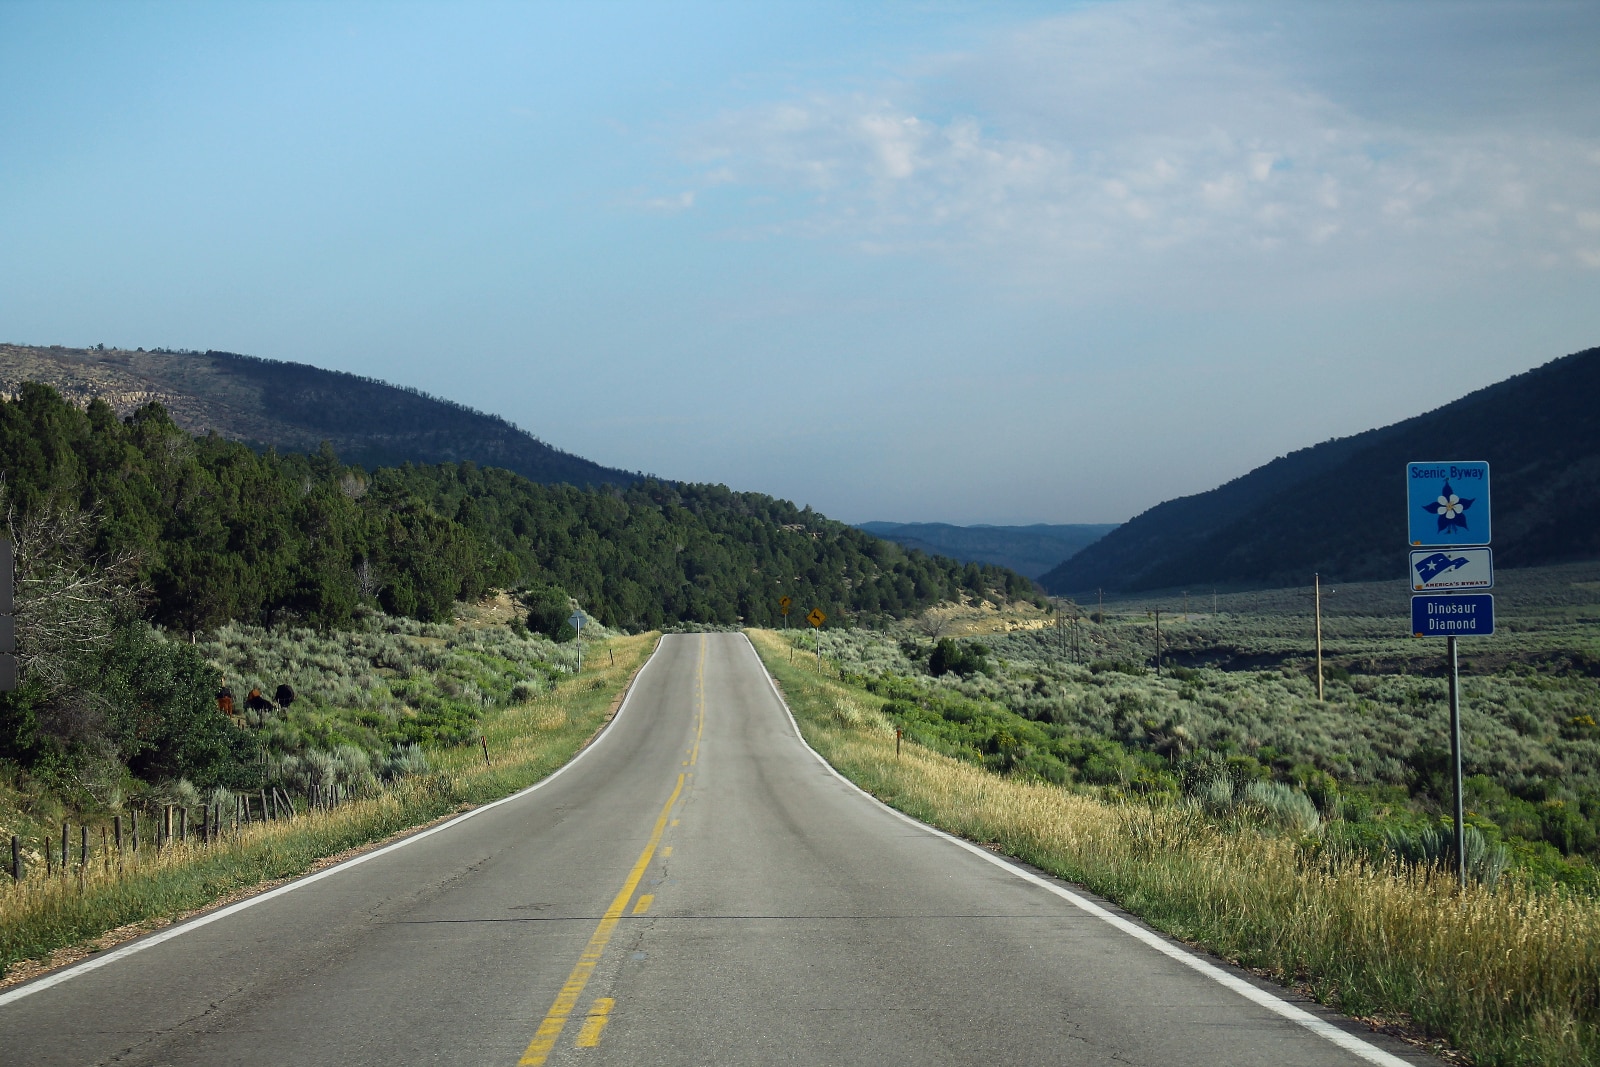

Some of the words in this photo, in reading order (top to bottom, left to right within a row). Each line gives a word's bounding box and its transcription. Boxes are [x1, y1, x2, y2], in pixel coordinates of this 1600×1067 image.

[1411, 466, 1446, 479] Scenic
[1450, 466, 1484, 480] Byway
[1427, 602, 1477, 614] Dinosaur
[1429, 618, 1476, 630] Diamond
